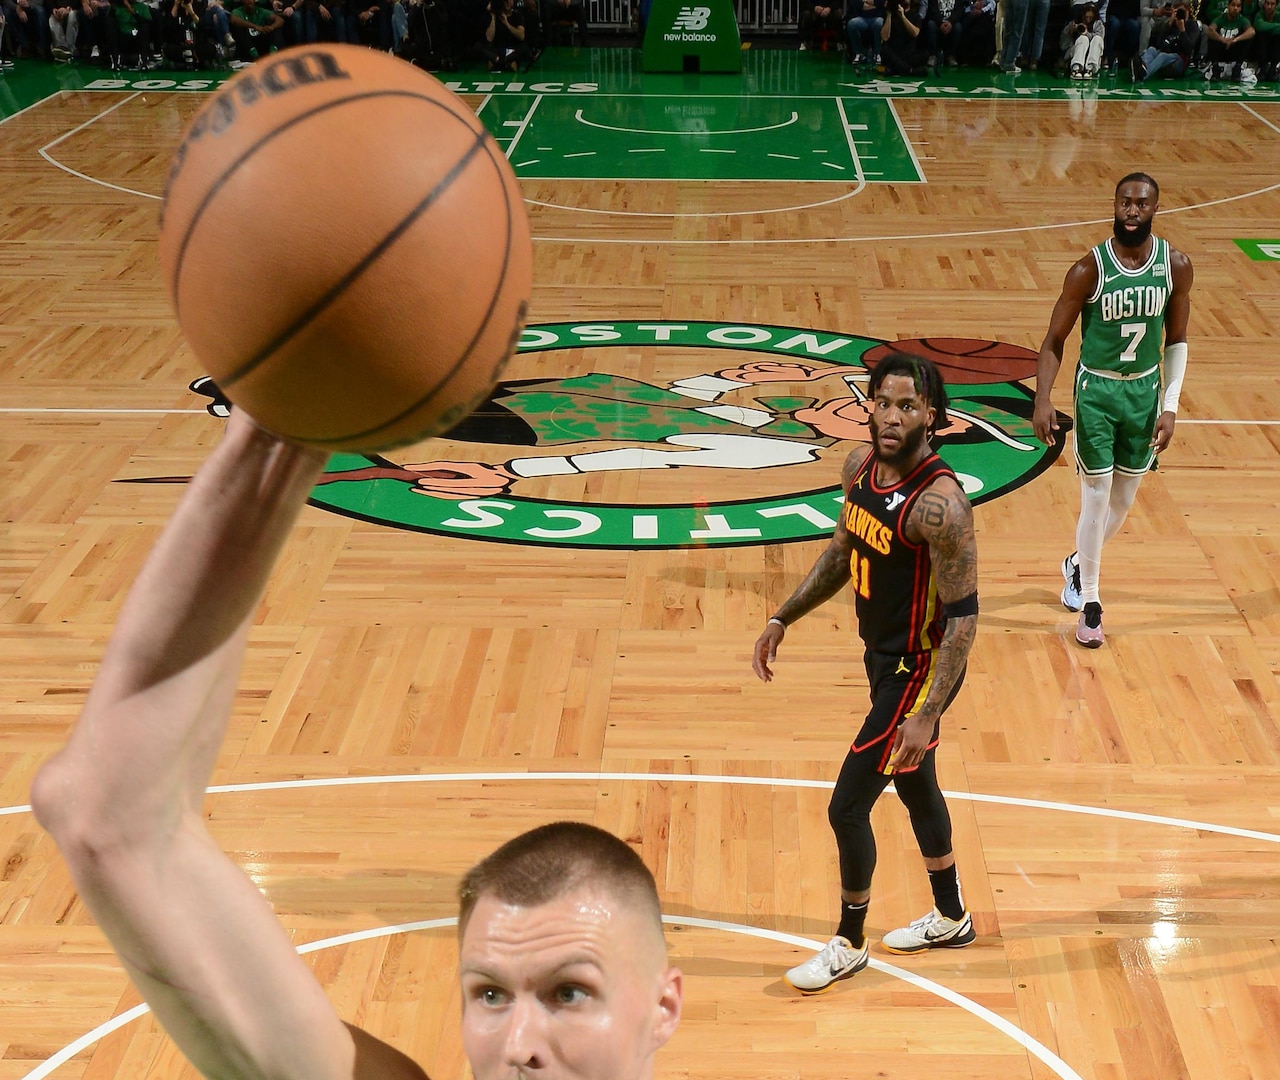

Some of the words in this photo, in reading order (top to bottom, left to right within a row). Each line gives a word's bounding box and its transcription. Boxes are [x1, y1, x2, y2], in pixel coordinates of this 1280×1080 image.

[664, 33, 680, 41] new
[682, 32, 716, 42] balance
[444, 82, 599, 92] LTICS
[1102, 286, 1166, 321] BOSTON
[518, 325, 852, 355] OSTON
[1120, 323, 1147, 361] 7
[844, 501, 893, 555] HAWKS
